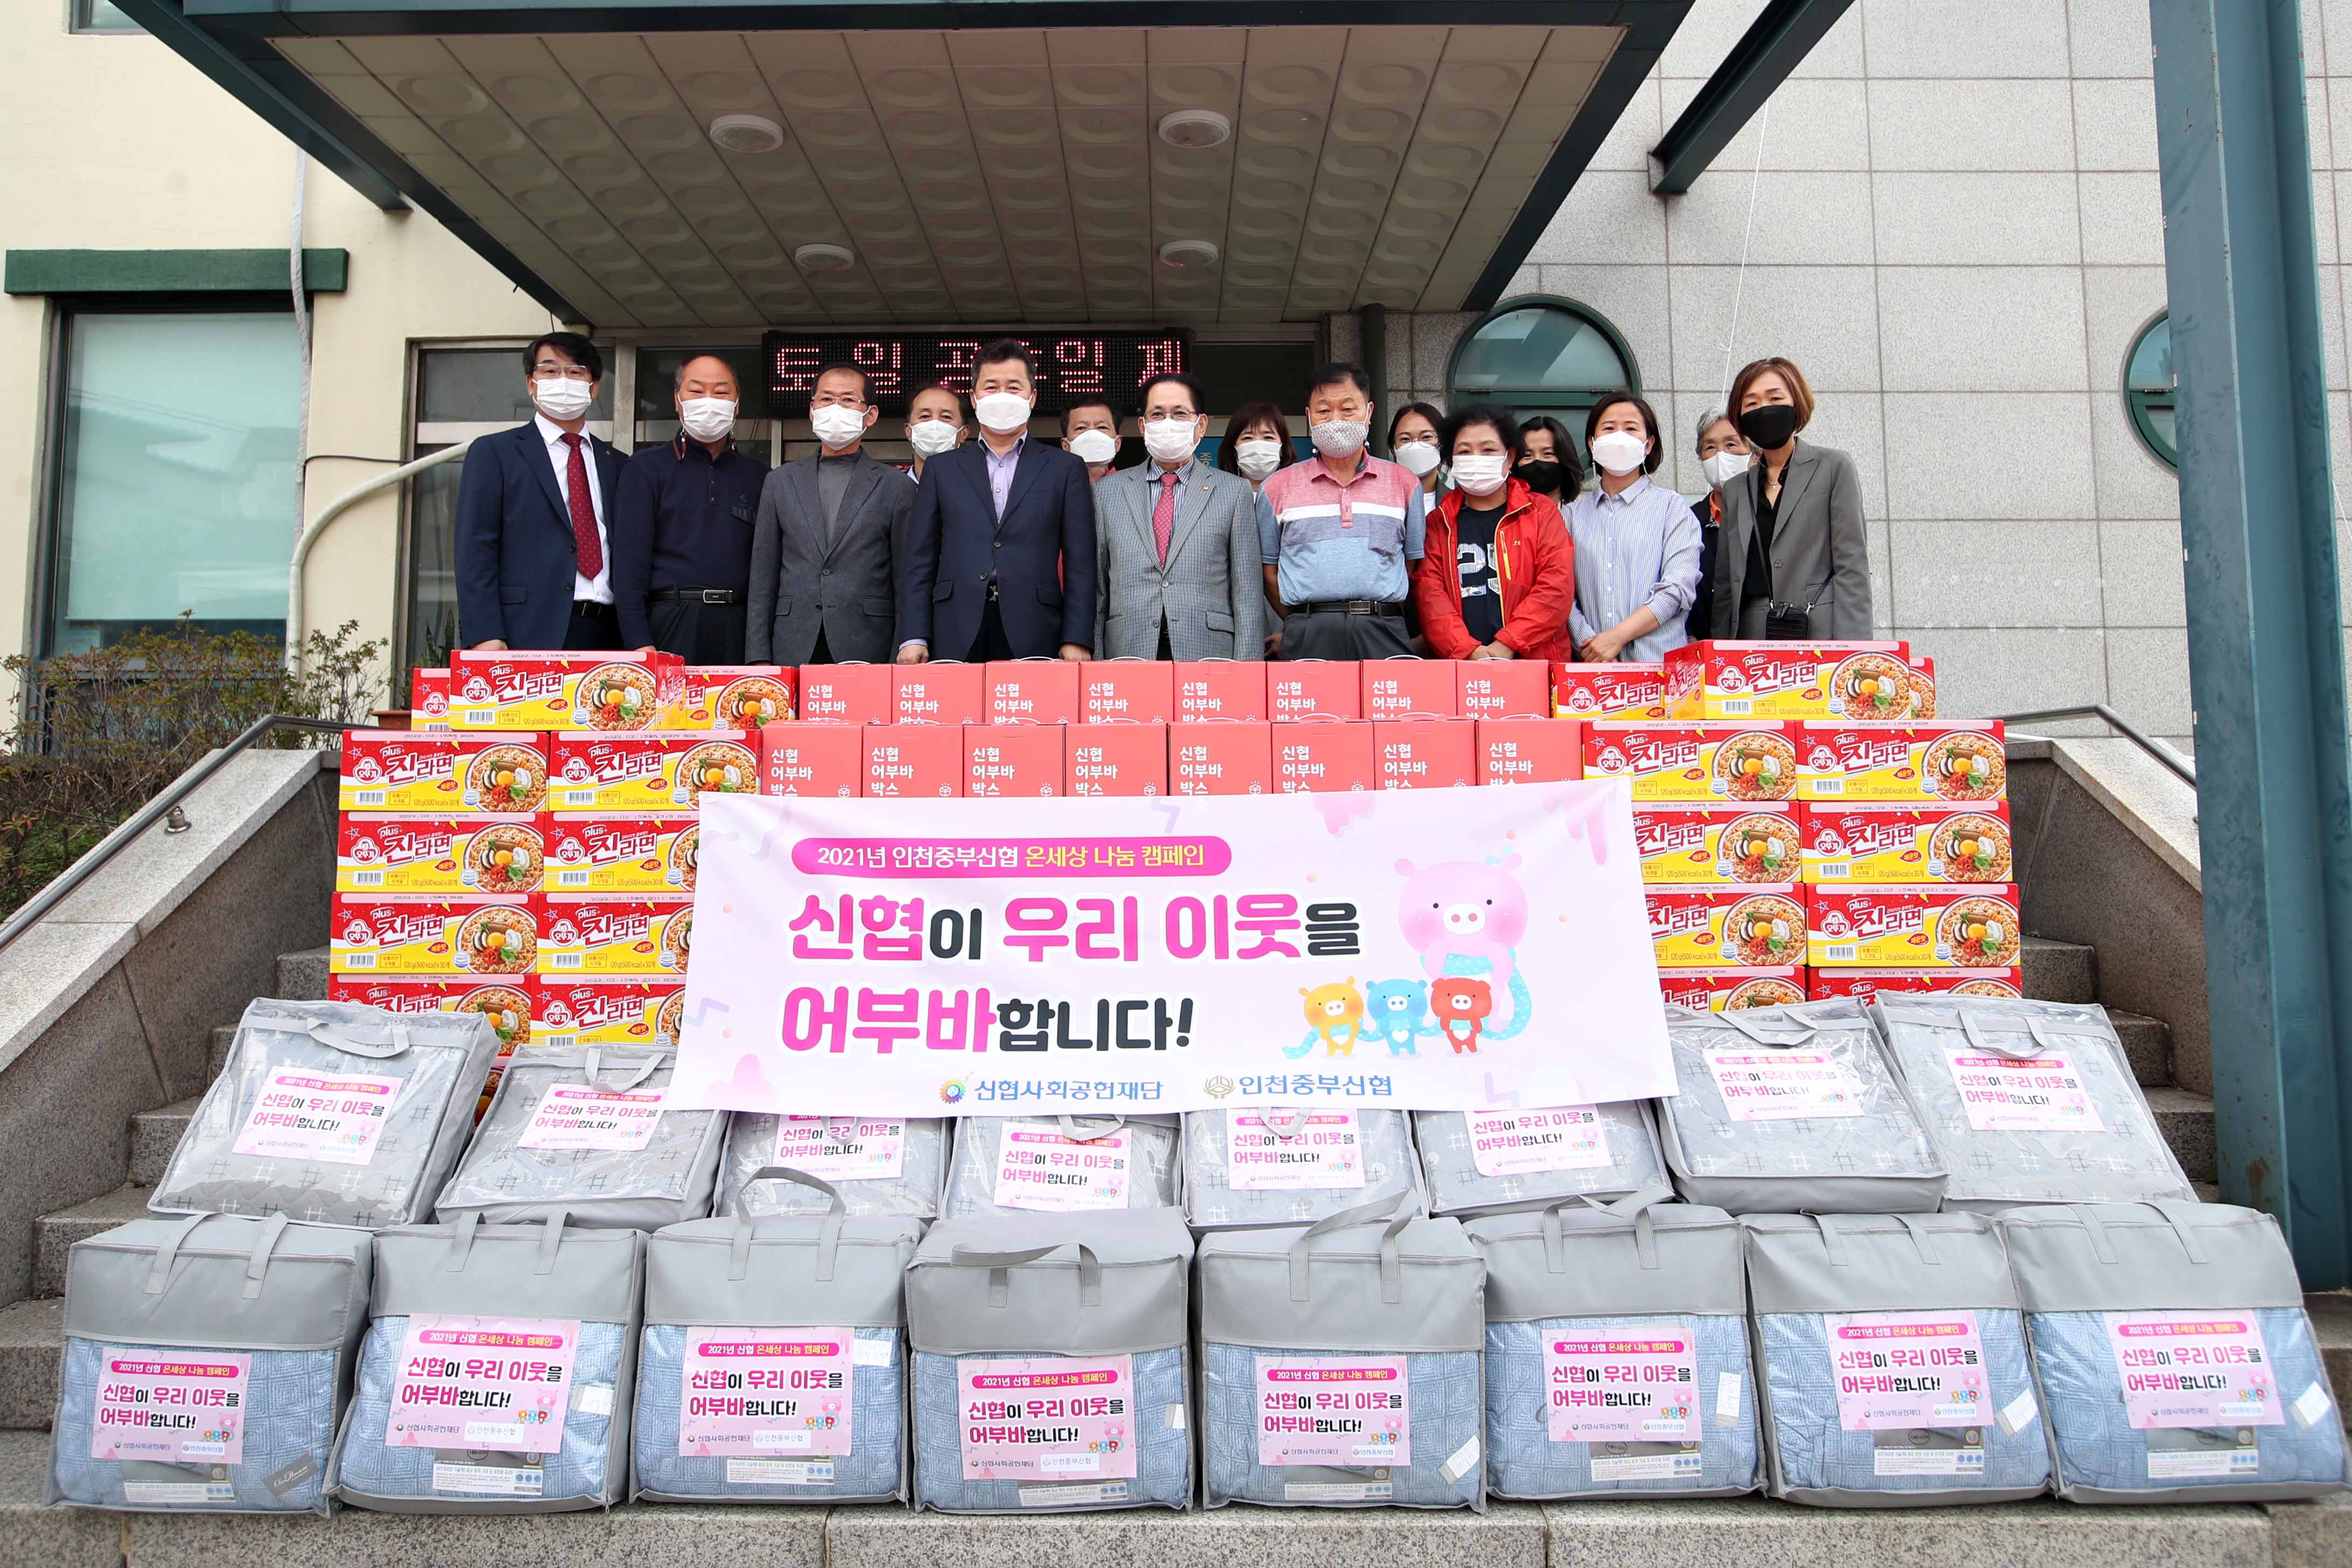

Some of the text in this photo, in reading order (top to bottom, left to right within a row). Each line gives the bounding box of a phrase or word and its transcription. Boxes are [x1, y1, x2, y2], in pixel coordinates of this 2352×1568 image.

[854, 342, 901, 393] 일
[935, 341, 1103, 393] 공일
[1749, 663, 1816, 694] 진라면
[495, 673, 563, 704] 진라면
[808, 685, 832, 698] 신협
[900, 684, 925, 698] 신협
[995, 683, 1019, 697] 신협
[1089, 683, 1114, 696] 신협
[1182, 682, 1208, 696] 신협
[1277, 682, 1301, 695] 신협
[1373, 681, 1398, 694] 신협
[1466, 680, 1490, 694] 신협
[1089, 698, 1128, 712] 어부바
[1182, 698, 1222, 711] 어부바
[1277, 698, 1315, 711] 어부바
[1372, 697, 1412, 710] 어부바
[1466, 697, 1505, 709] 어부바
[1599, 683, 1660, 712] 진라면
[808, 701, 846, 714] 어부바
[900, 701, 939, 713] 어부바
[994, 700, 1033, 713] 어부바
[772, 749, 798, 764] 신협
[872, 747, 899, 762] 신협
[973, 747, 999, 762] 신협
[1076, 747, 1103, 762] 신협
[1180, 746, 1207, 761] 신협
[1282, 745, 1310, 760] 신협
[1384, 744, 1411, 759] 신협
[1489, 742, 1517, 758] 신협
[1630, 743, 1698, 772] 진라면
[1842, 741, 1908, 772] 진라면
[386, 753, 453, 783] 진라면
[595, 752, 662, 782] 진라면
[771, 767, 813, 781] 어부바
[871, 765, 913, 779] 어부바
[972, 765, 1014, 779] 어부바
[1075, 765, 1118, 779] 어부바
[1180, 764, 1223, 778] 어부바
[1282, 763, 1325, 778] 어부바
[1384, 761, 1427, 775] 어부바
[1490, 760, 1534, 775] 어부바
[771, 784, 798, 796] 박스
[871, 782, 899, 796] 박스
[972, 782, 1000, 796] 박스
[1075, 782, 1103, 796] 박스
[1180, 781, 1208, 795] 박스
[1282, 780, 1311, 794] 박스
[1847, 825, 1914, 856] 진라면
[589, 834, 655, 864] 진라면
[817, 844, 1205, 869] 2021년 인천중부신협 온세상 나눔 캠페인
[788, 893, 1361, 962] 신협이 우리 이웃을
[1854, 907, 1922, 938] 진라면
[781, 986, 1194, 1054] 어부바합니다!
[975, 1074, 1392, 1101] 신협사회공헌재단 인천중부신협
[262, 1093, 385, 1117] 신협이 우리 이웃을
[543, 1103, 658, 1119] 신협이 우리 이웃을
[253, 1113, 340, 1132] 어부바합니다!
[535, 1117, 618, 1131] 어부바합니다!
[1473, 1111, 1594, 1135] 신협이 우리 이웃을
[1476, 1133, 1563, 1152] 어부바합니다!
[1005, 1150, 1124, 1170] 신협이 우리 이웃을
[1002, 1168, 1088, 1186] 어부바합니다!
[430, 1333, 456, 1343] 2021년
[708, 1345, 734, 1354] 2021년
[2124, 1347, 2260, 1366] 신협이 우리 이웃을
[1839, 1348, 1977, 1368] 신협이 우리 이웃을
[409, 1358, 562, 1382] 신협이 우리 이웃을
[1553, 1365, 1690, 1383] 신협이 우리 이웃을
[692, 1370, 842, 1389] 신협이 우리 이웃을
[983, 1377, 1010, 1387] 2021년
[1842, 1376, 1940, 1392] 어부바합니다!
[2128, 1375, 2225, 1390] 어부바합니다!
[104, 1385, 239, 1406] 신협이 우리 이웃을
[402, 1384, 510, 1407] 어부바합니다!
[1266, 1392, 1402, 1409] 신협이 우리 이웃을
[1554, 1390, 1650, 1406] 어부바합니다!
[691, 1397, 796, 1415] 어부바합니다!
[970, 1397, 1123, 1420] 신협이 우리 이웃을
[102, 1408, 195, 1428] 어부바합니다!
[1265, 1416, 1361, 1432] 어부바합니다!
[970, 1427, 1078, 1443] 어부바합니다!
